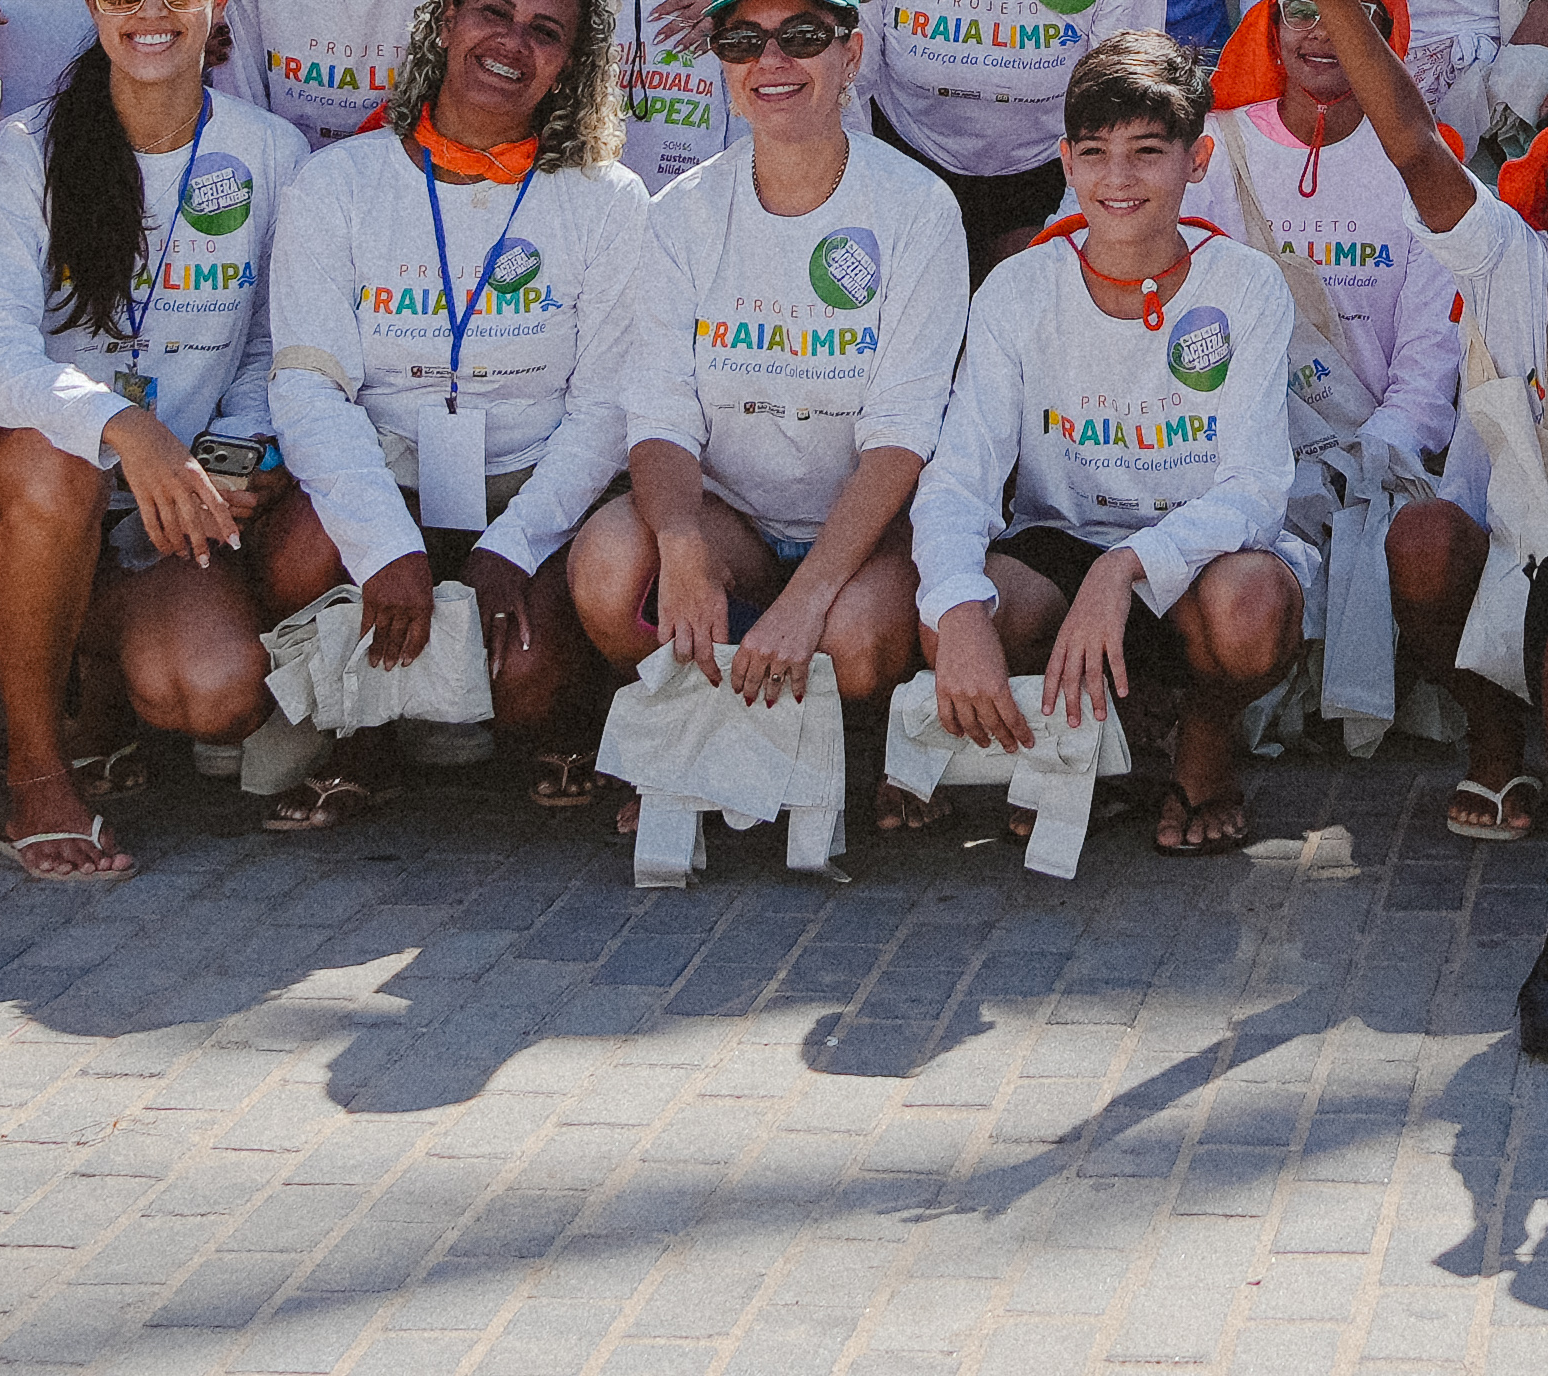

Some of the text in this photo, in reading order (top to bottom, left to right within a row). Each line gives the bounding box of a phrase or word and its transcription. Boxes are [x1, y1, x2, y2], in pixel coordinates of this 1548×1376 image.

[893, 6, 1082, 49] PRAIA LIMPA
[267, 50, 358, 91] PRAIA
[922, 46, 1066, 70] Força da Coletividade
[619, 70, 713, 97] UNDIAL DA
[299, 90, 356, 108] Força da
[1309, 241, 1394, 268] LIMPA
[163, 262, 256, 290] LIMPA
[154, 298, 240, 313] Coletividade
[386, 324, 427, 340] Força
[694, 319, 879, 357] PRAIA LIMPA
[724, 359, 866, 381] Força da Coletividade
[1081, 392, 1182, 415] PROJETO
[1044, 408, 1218, 451] PRAIA LIMPA
[1079, 449, 1218, 473] Força da Coletividade
